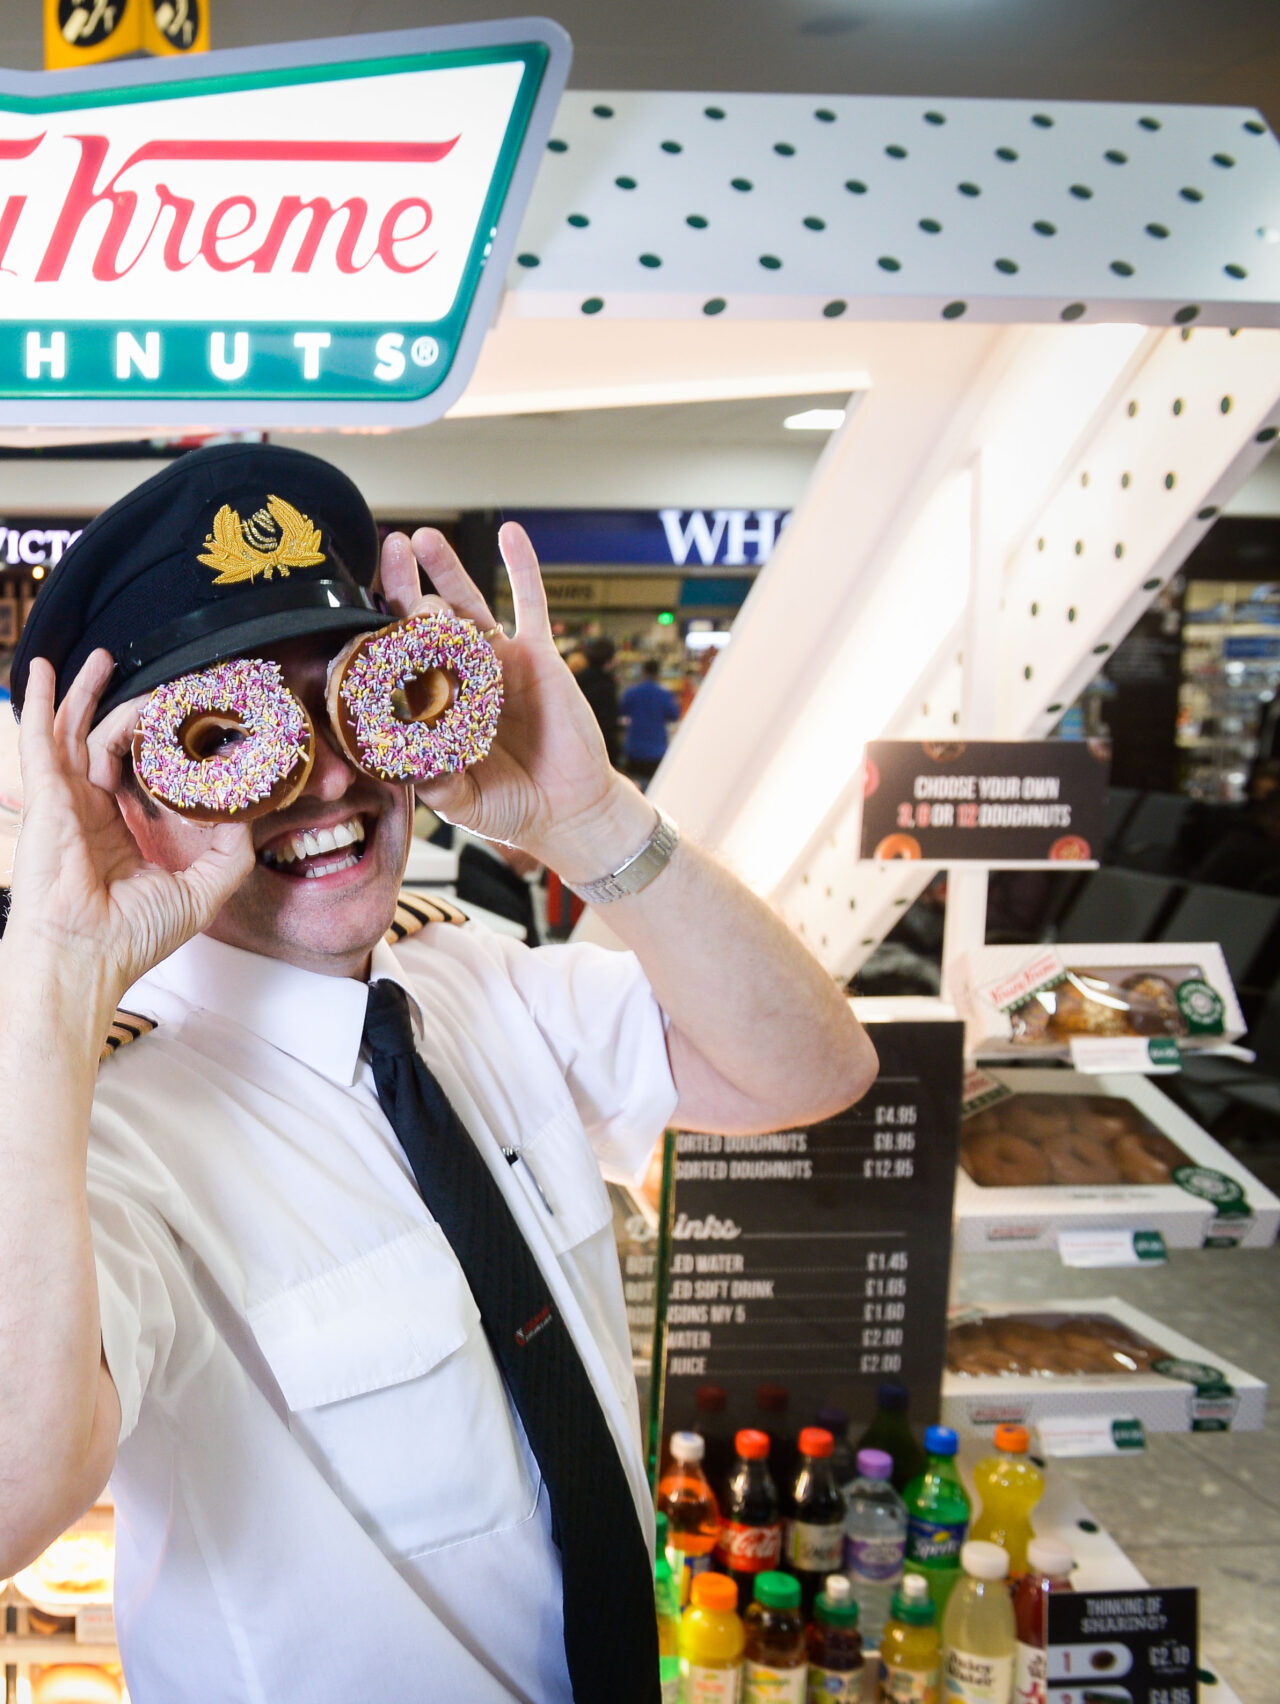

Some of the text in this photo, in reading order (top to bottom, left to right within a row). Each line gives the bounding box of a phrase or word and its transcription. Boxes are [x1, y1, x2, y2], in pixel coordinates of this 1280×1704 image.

[34, 133, 462, 282] Kreme
[658, 508, 792, 565] WH
[914, 775, 1060, 799] CHOOSE YOUR OWN
[931, 803, 954, 826] OR
[978, 804, 1071, 827] DOUGHNUTS
[729, 1160, 812, 1179] DOUGHNUTS
[695, 1254, 744, 1273] WATER
[694, 1281, 728, 1299] SOFT
[730, 1281, 774, 1299] DRINK
[1086, 1597, 1162, 1616] THINKING OF
[1081, 1616, 1168, 1633] SHARING?
